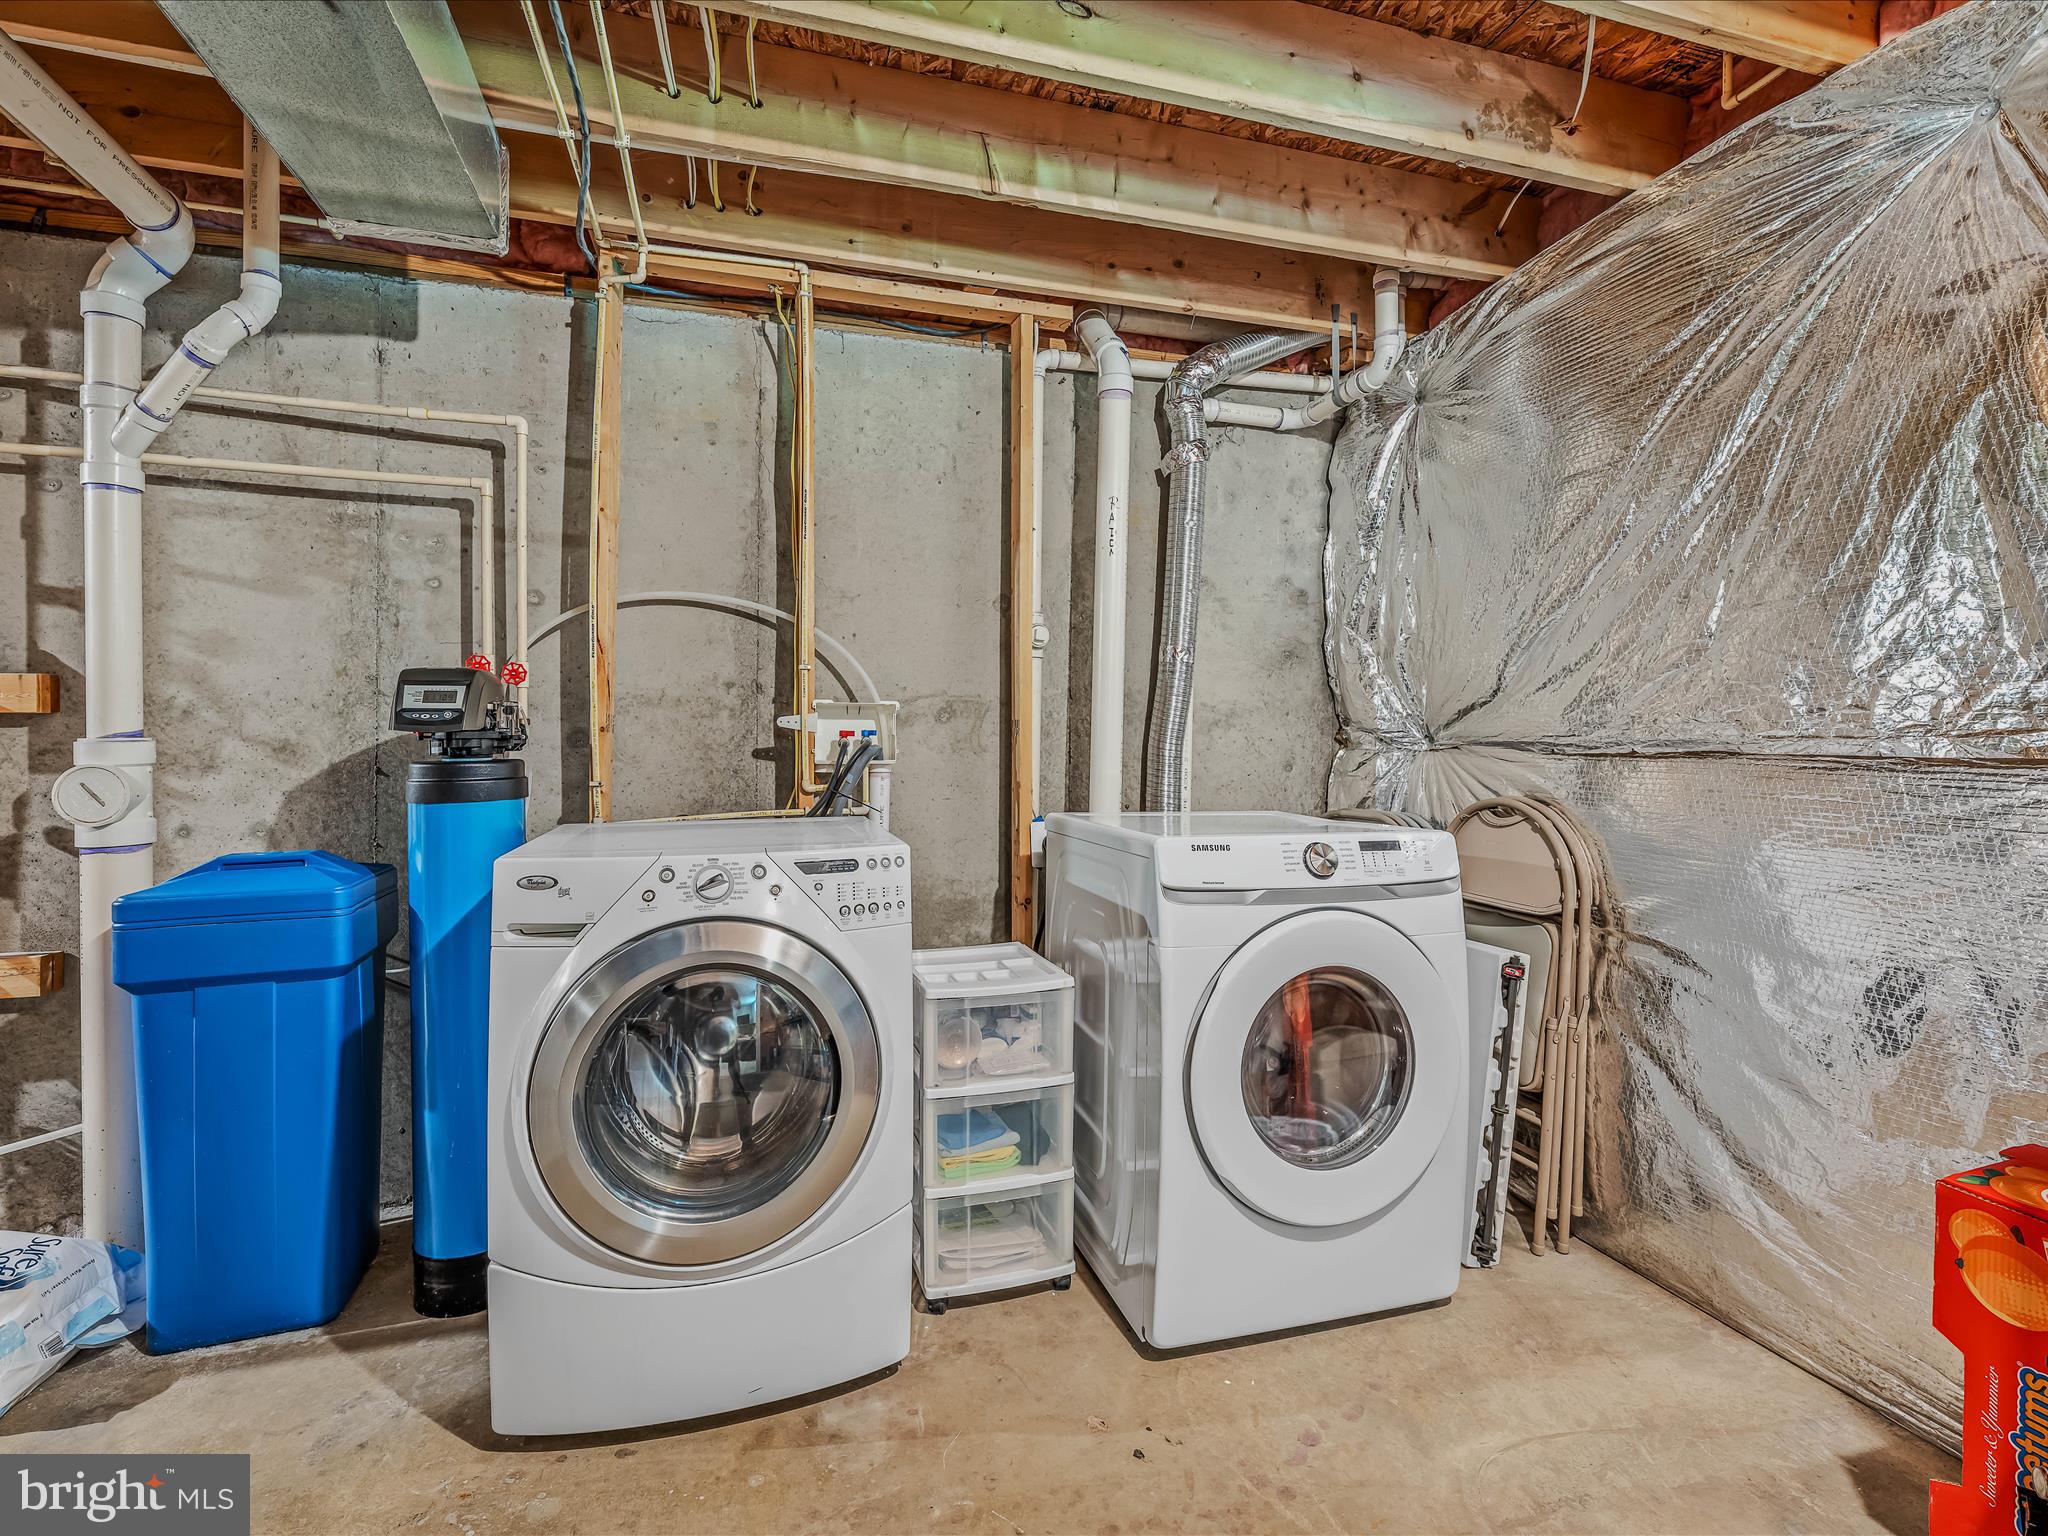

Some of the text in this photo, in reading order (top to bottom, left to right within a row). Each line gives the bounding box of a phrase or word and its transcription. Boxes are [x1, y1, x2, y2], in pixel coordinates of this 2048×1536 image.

[58, 102, 161, 201] NOT FOR PRESSURE
[158, 383, 191, 420] NOT FO
[1191, 844, 1231, 852] SAMSUNG
[14, 1236, 62, 1270] Sure
[1978, 1365, 2004, 1508] Sweeter & Yummier
